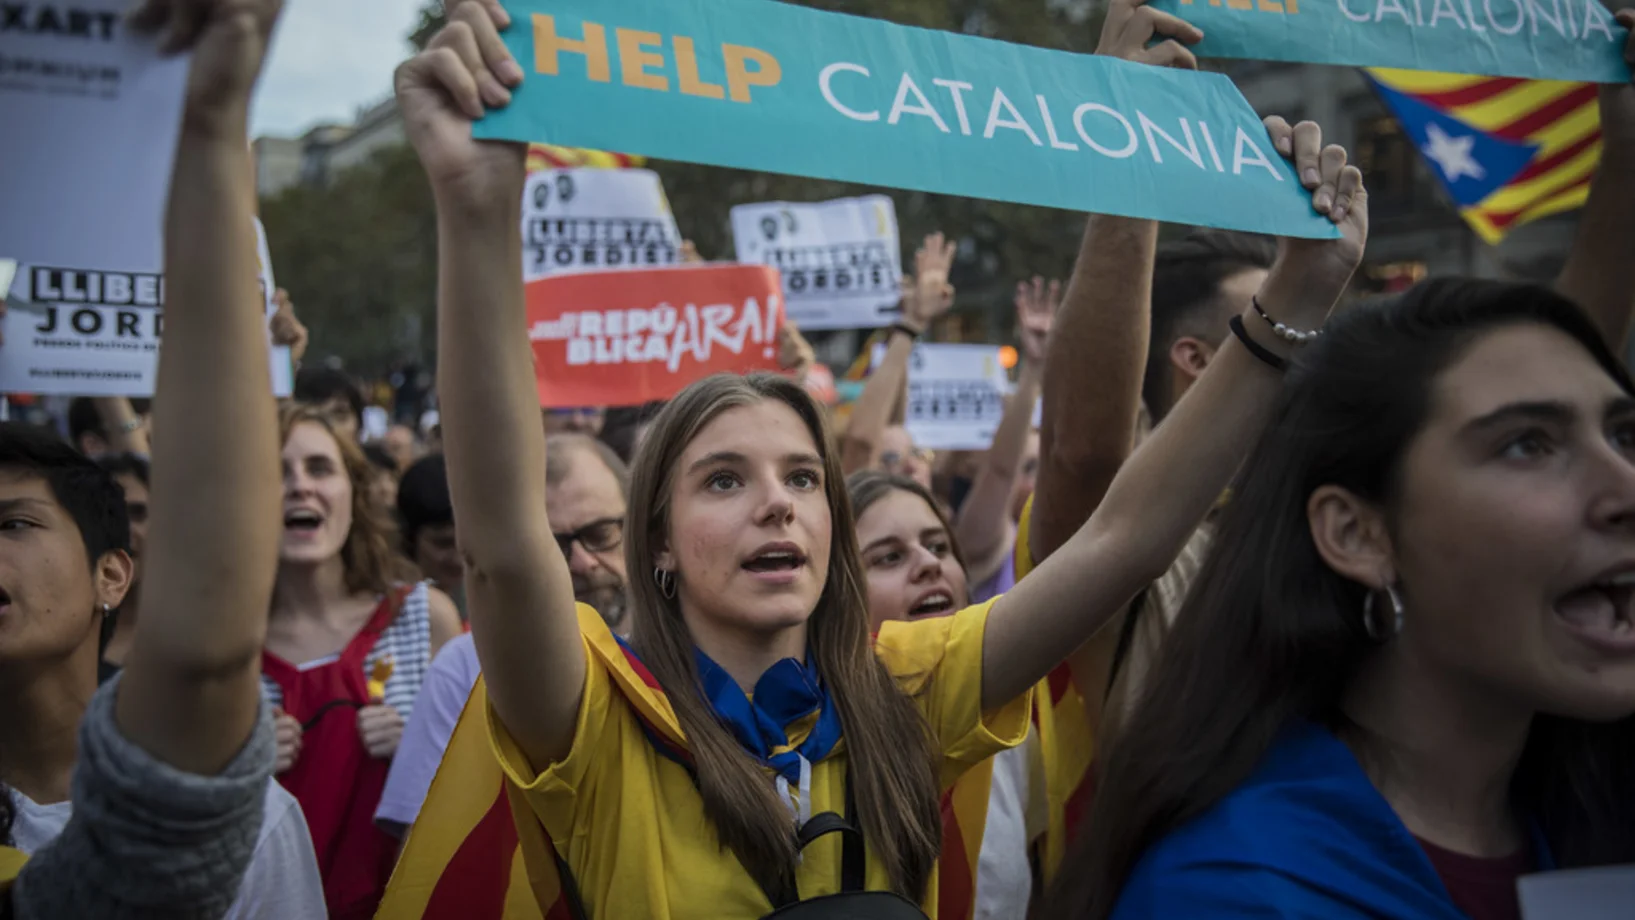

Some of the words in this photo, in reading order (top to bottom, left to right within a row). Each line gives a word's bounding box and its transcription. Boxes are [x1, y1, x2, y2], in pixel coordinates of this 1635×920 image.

[530, 12, 783, 104] HELP
[818, 61, 1285, 182] CATALONIA
[33, 268, 164, 304] LLIBE
